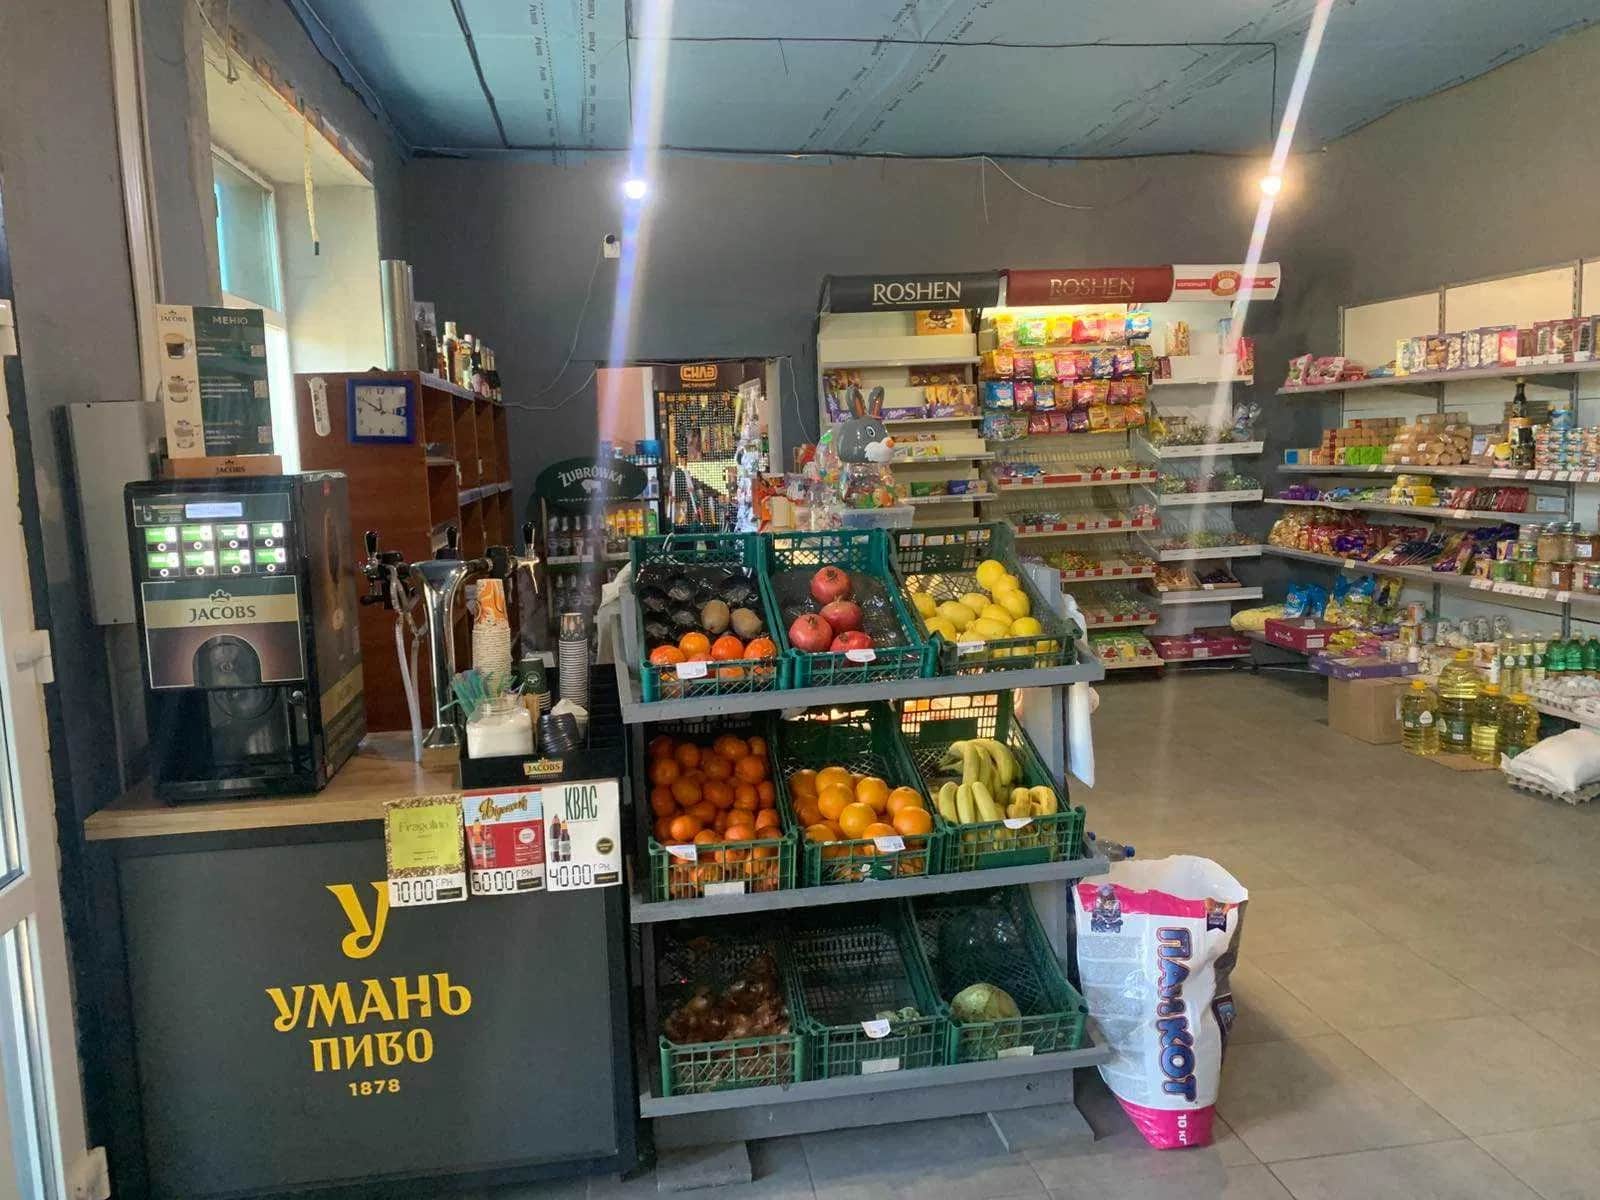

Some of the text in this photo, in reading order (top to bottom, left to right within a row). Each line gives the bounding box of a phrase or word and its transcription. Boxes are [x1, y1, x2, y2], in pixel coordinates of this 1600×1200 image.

[873, 281, 962, 304] ROSHEN
[1050, 277, 1135, 298] ROSHEN
[212, 315, 248, 325] МЕНЮ
[216, 465, 246, 474] JACOBS
[189, 605, 256, 623] JACOBS
[526, 763, 561, 773] JACOBS
[565, 785, 598, 820] КВАС
[265, 972, 472, 1032] УМАНЬ
[309, 1028, 433, 1072] ПИВО
[349, 1079, 401, 1096] 1878
[1177, 1114, 1188, 1128] 10
